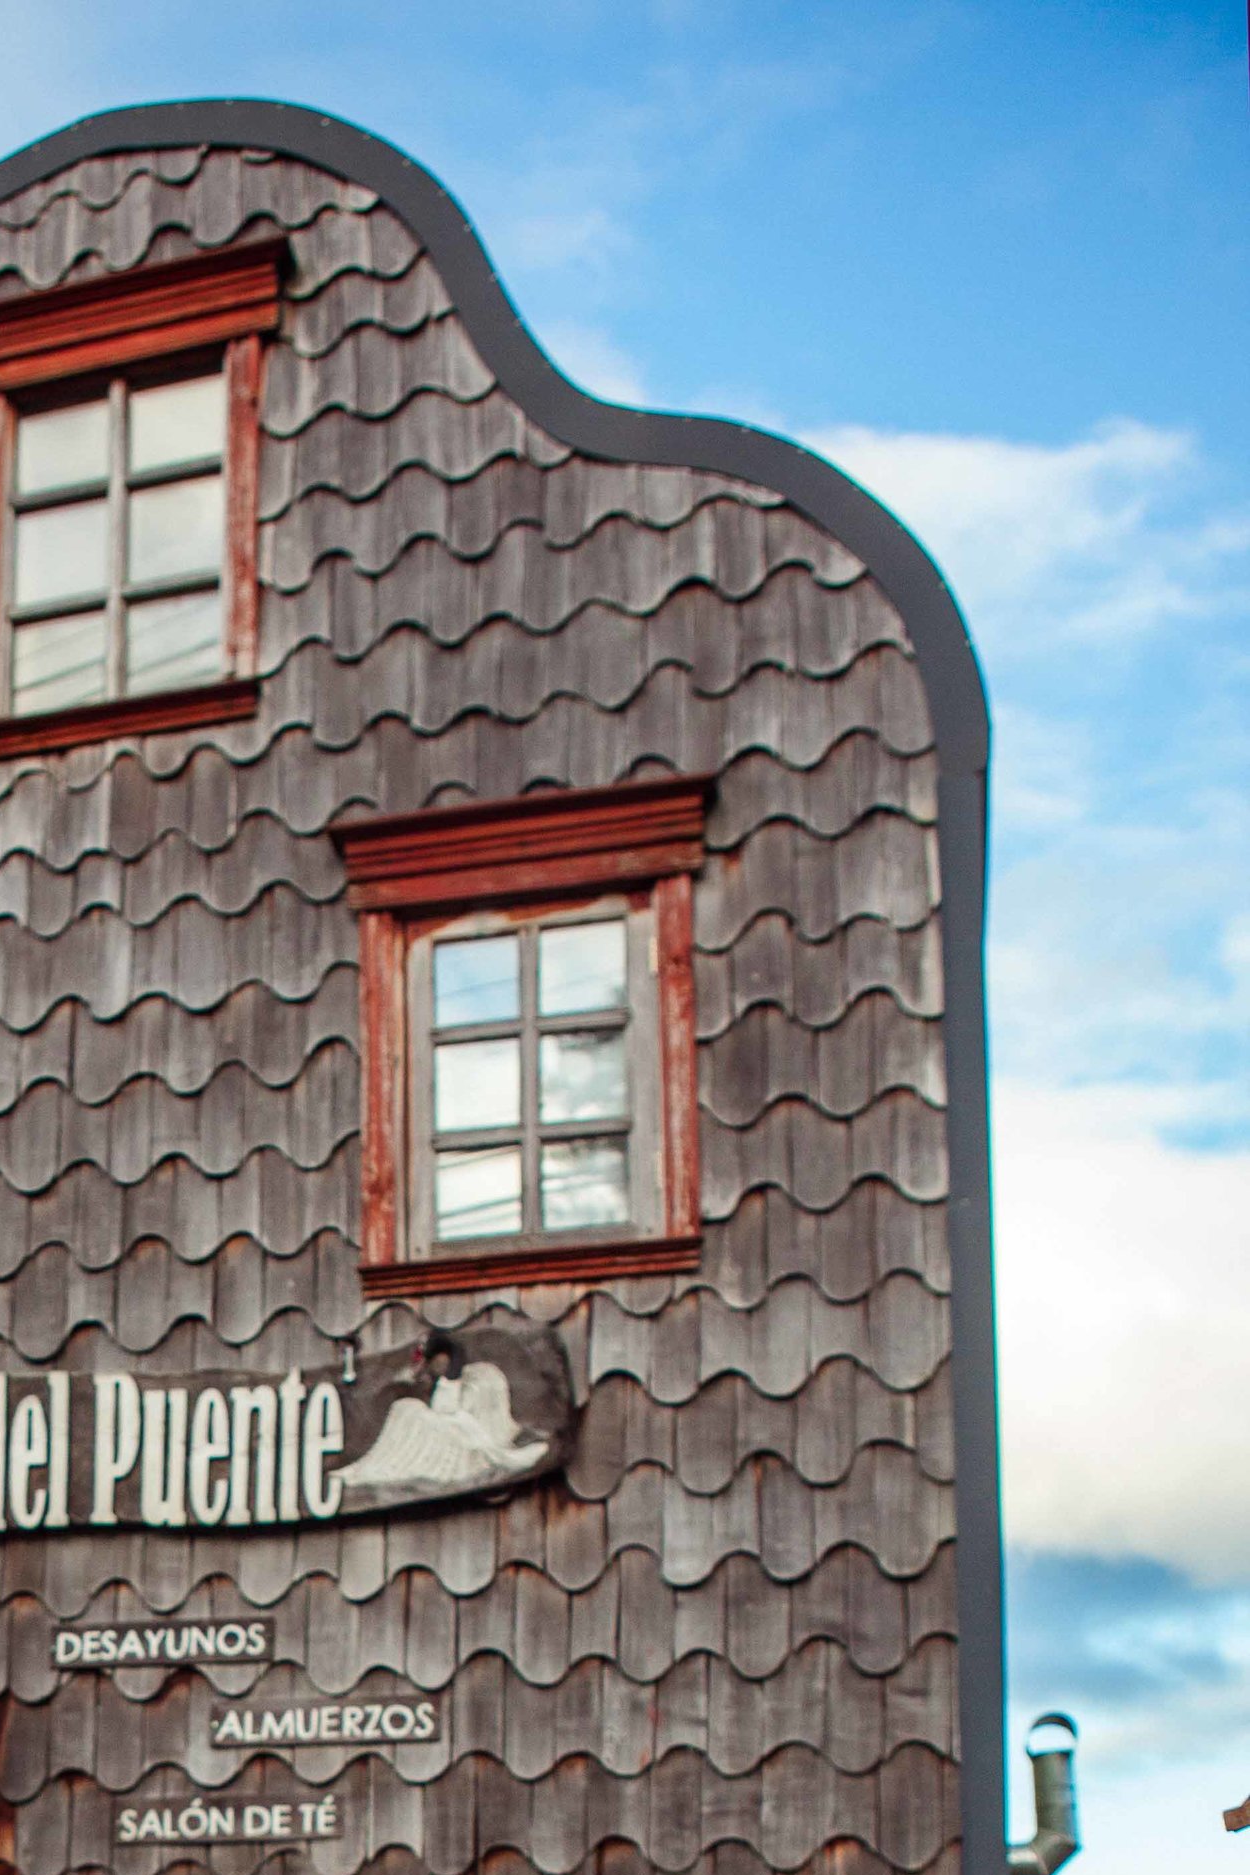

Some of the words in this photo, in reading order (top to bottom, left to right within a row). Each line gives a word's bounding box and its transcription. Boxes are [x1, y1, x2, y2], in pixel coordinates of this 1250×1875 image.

[88, 1366, 345, 1526] Puente
[55, 1623, 266, 1663] DESAYUNOS
[214, 1702, 436, 1741] ALMUERZOS
[118, 1798, 236, 1842] SALÓN
[243, 1806, 291, 1837] DE
[300, 1794, 338, 1834] TÉ
